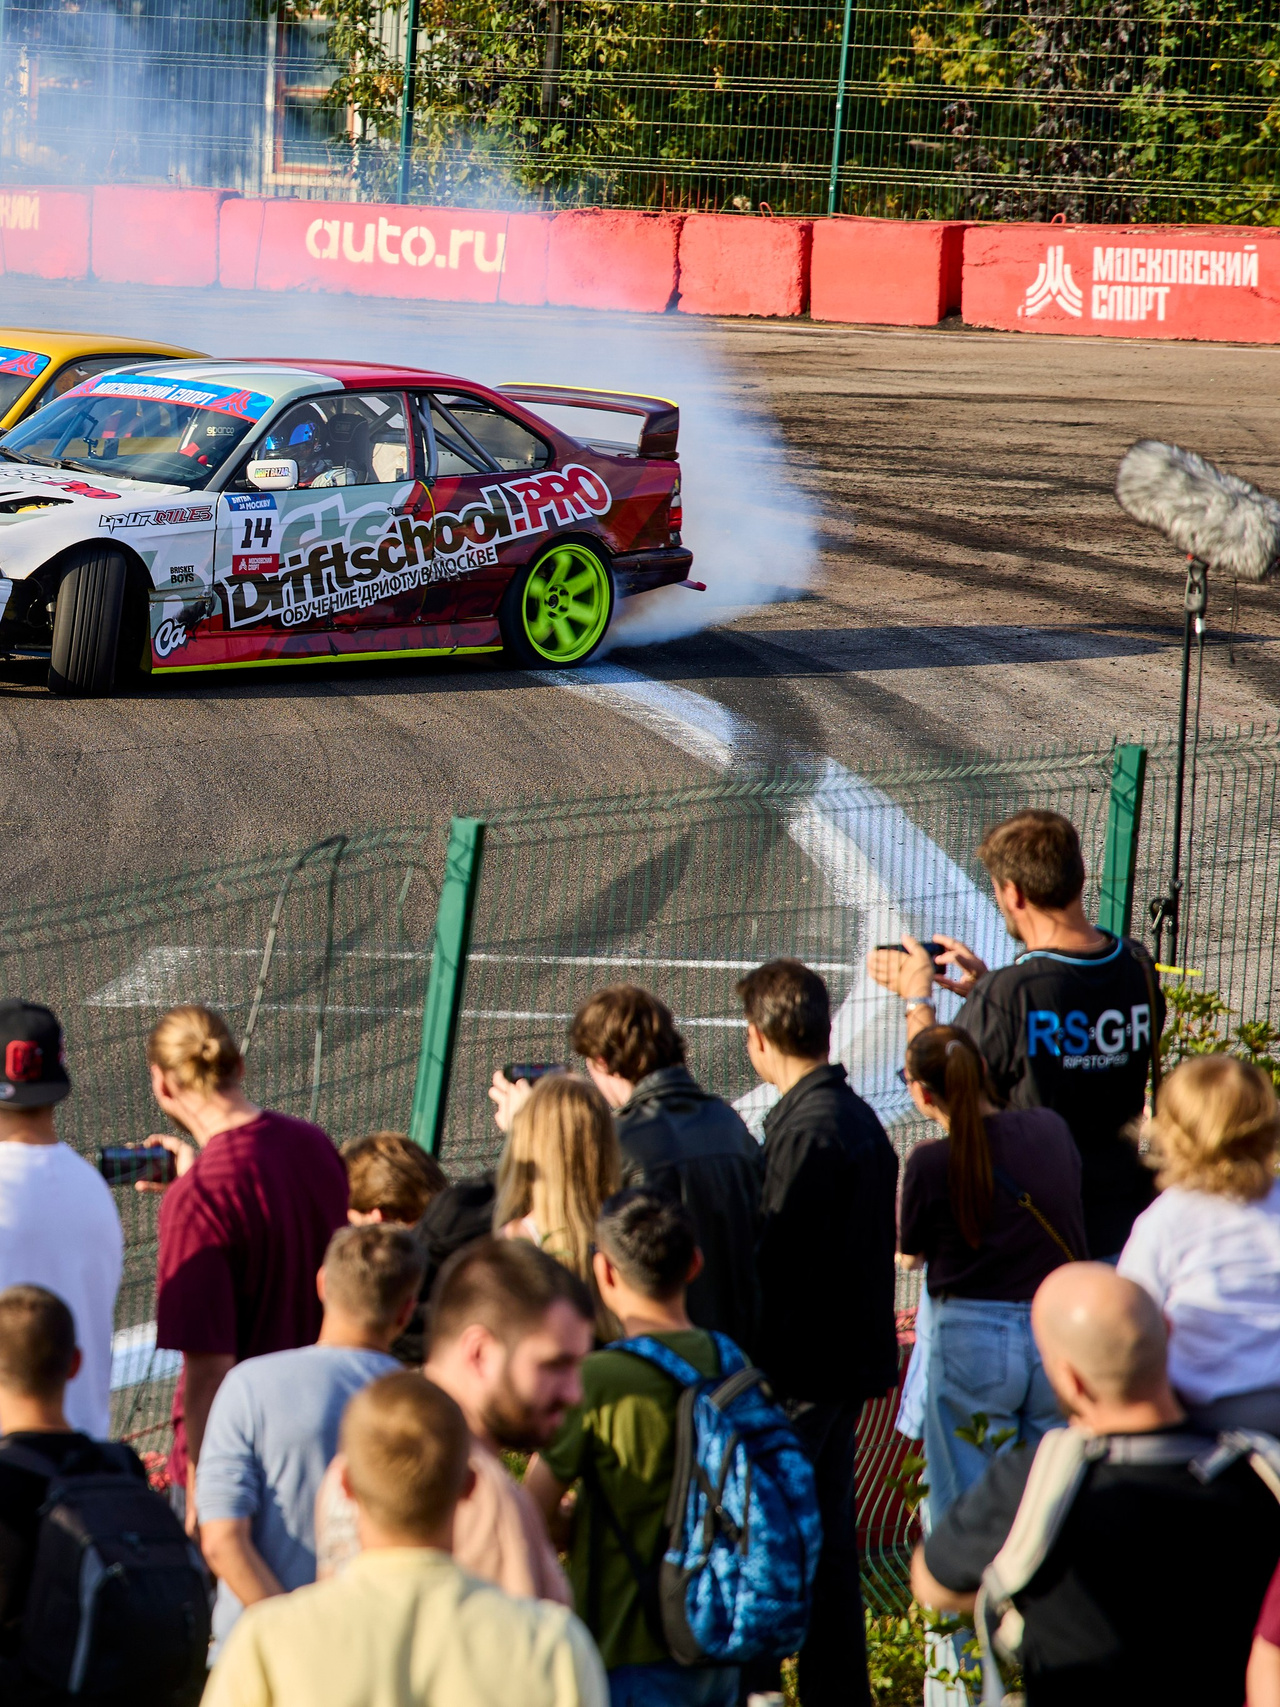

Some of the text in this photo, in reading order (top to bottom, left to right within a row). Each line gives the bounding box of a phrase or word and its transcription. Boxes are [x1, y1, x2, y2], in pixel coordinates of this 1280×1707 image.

[305, 216, 507, 273] auto.ru
[1092, 244, 1259, 287] МОСКОВСКИЙ
[1091, 284, 1170, 321] СПОРТ
[90, 382, 218, 406] МОСКОВСКИЙ СПОРТ
[241, 518, 273, 549] 14
[170, 565, 195, 574] BRISKET
[170, 572, 195, 584] BOYS
[281, 588, 358, 626] ОБУЧЕНИЕ
[360, 569, 419, 604] ДРИФТУ
[433, 546, 498, 578] МОСКВЕ
